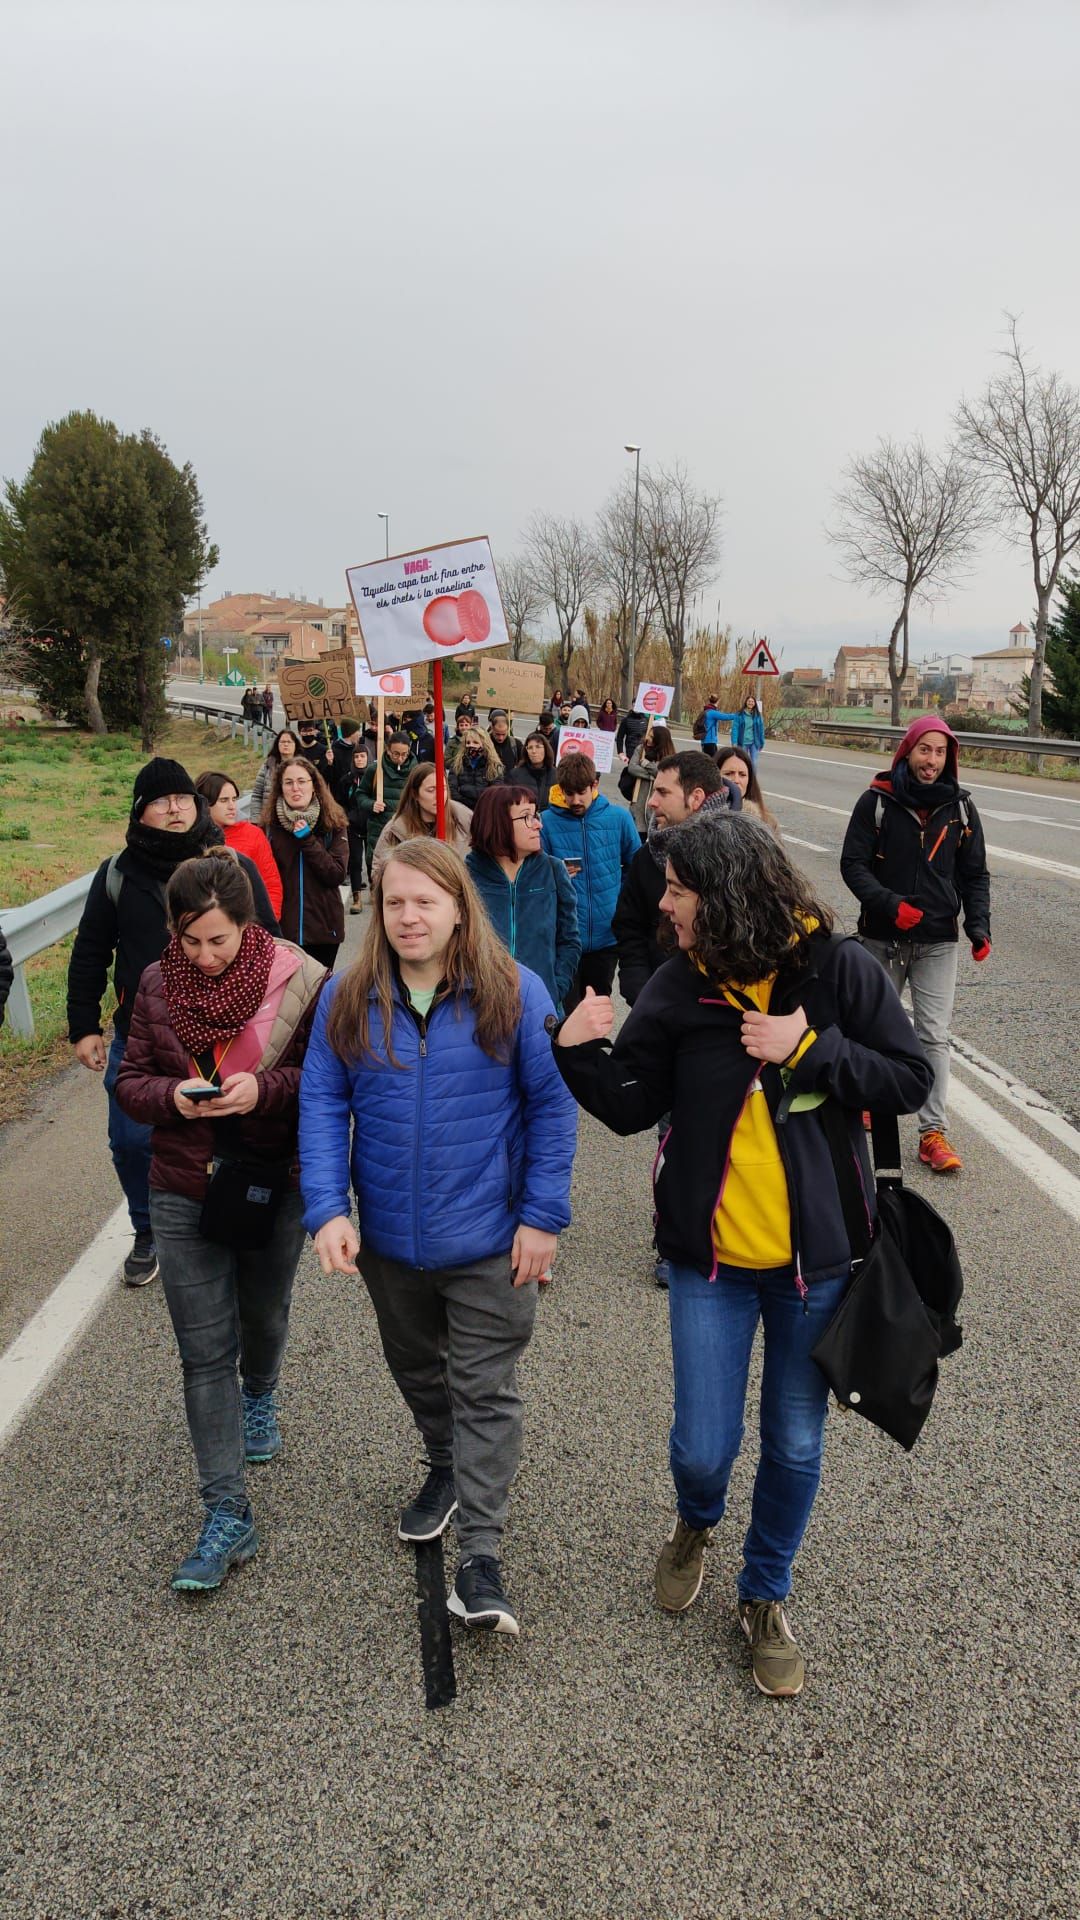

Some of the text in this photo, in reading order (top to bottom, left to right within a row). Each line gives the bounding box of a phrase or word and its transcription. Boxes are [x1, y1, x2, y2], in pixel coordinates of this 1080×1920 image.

[397, 578, 419, 590] capa
[421, 572, 439, 583] tant
[440, 568, 459, 583] fina
[461, 563, 486, 574] entre
[404, 558, 432, 576] VAGA:
[376, 598, 390, 609] els
[391, 594, 415, 605] drets
[417, 589, 422, 600] i
[424, 588, 434, 598] la
